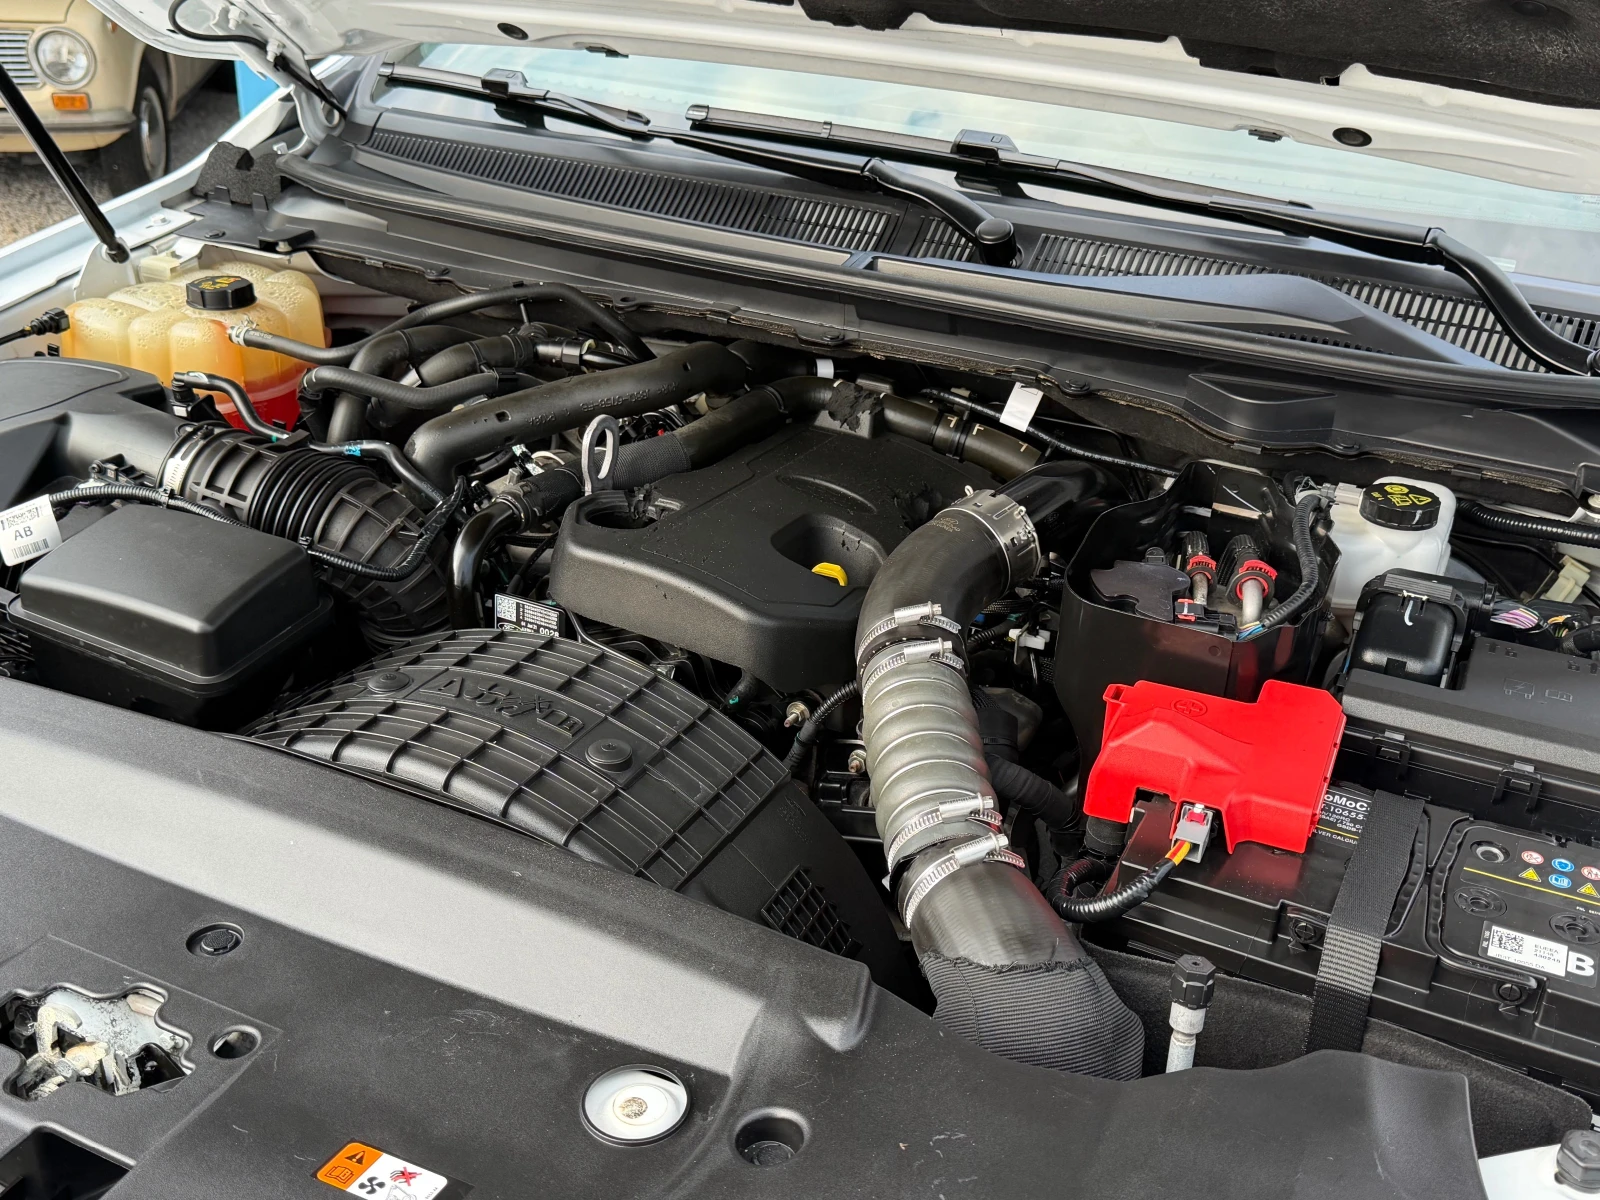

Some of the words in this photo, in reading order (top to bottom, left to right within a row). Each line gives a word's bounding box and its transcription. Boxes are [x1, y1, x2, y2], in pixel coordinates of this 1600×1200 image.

[14, 526, 33, 541] AB
[1324, 794, 1370, 811] oMoC
[1567, 950, 1595, 976] B
